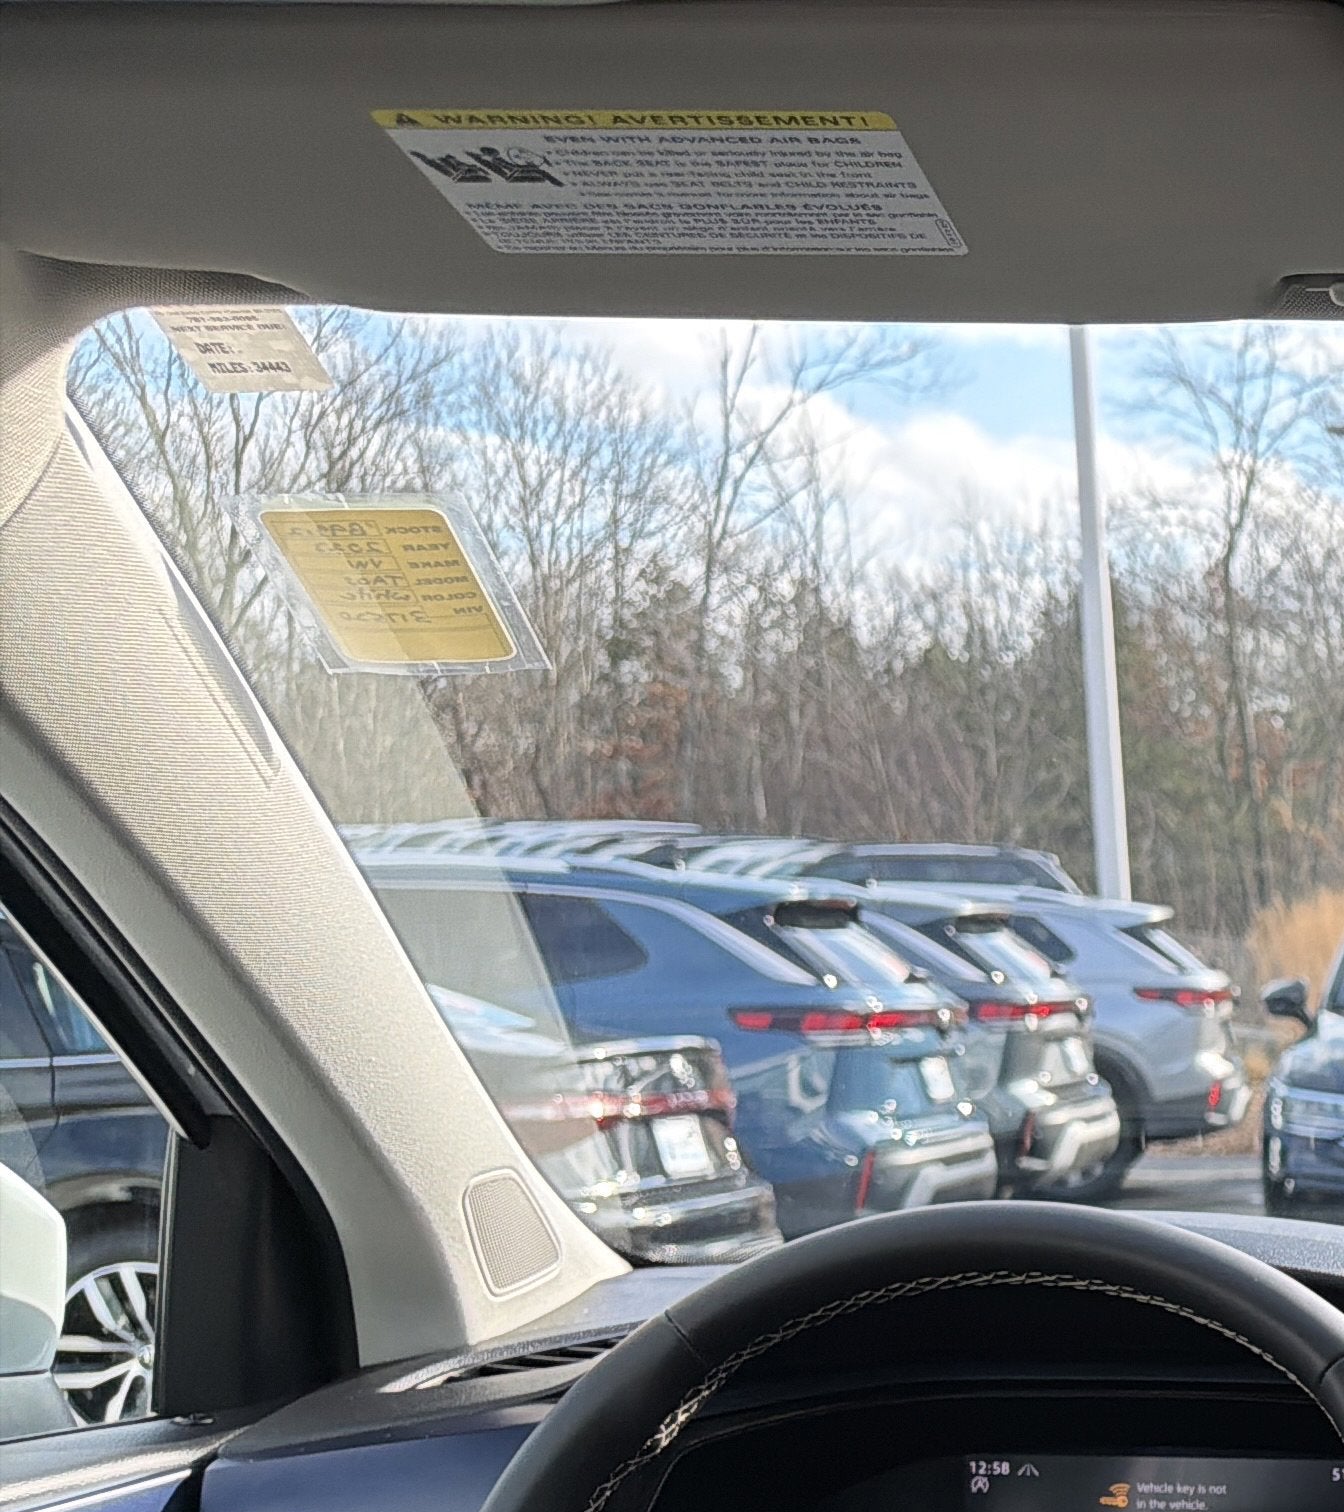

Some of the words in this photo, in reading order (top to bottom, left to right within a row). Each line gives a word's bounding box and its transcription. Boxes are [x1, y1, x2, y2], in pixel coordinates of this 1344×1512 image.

[432, 113, 598, 126] WARNING!
[611, 113, 870, 127] AVERTISSEMENT!
[600, 135, 652, 144] WITH
[659, 135, 762, 145] ADVANCED
[770, 136, 803, 145] AIR
[807, 136, 863, 145] BAGS
[205, 324, 256, 332] SERVICE
[194, 341, 236, 355] DATE:
[1136, 1481, 1173, 1495] Vehicle
[1176, 1482, 1195, 1499] key
[1198, 1483, 1206, 1495] is
[1209, 1483, 1227, 1496] not
[1136, 1497, 1145, 1509] in
[1148, 1496, 1166, 1509] the
[1168, 1497, 1209, 1511] vehicle.
